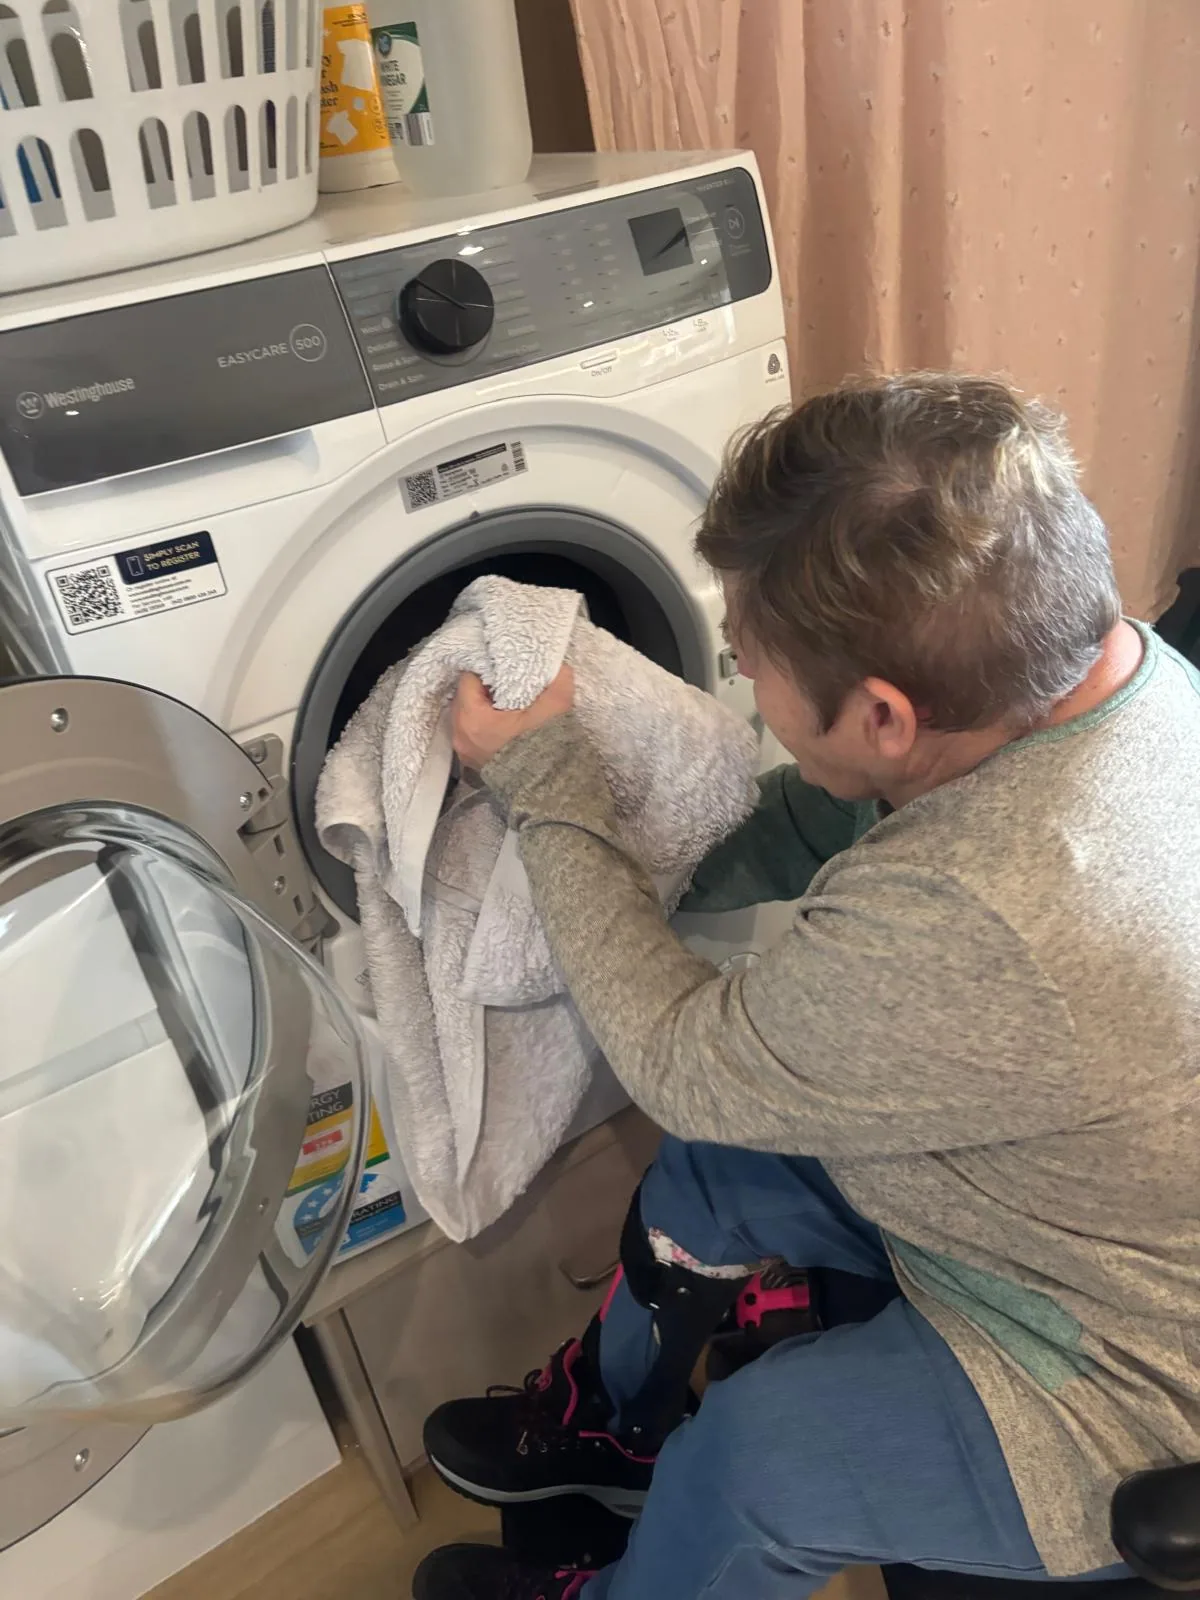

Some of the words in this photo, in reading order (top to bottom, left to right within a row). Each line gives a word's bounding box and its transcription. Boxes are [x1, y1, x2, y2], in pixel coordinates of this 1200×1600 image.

[216, 342, 289, 368] EASYCARE
[295, 335, 321, 351] 500
[43, 377, 135, 409] Westinghouse
[144, 547, 173, 562] SIMPLY
[174, 541, 200, 553] SCAN
[146, 562, 160, 571] TO
[160, 551, 200, 567] REGISTER
